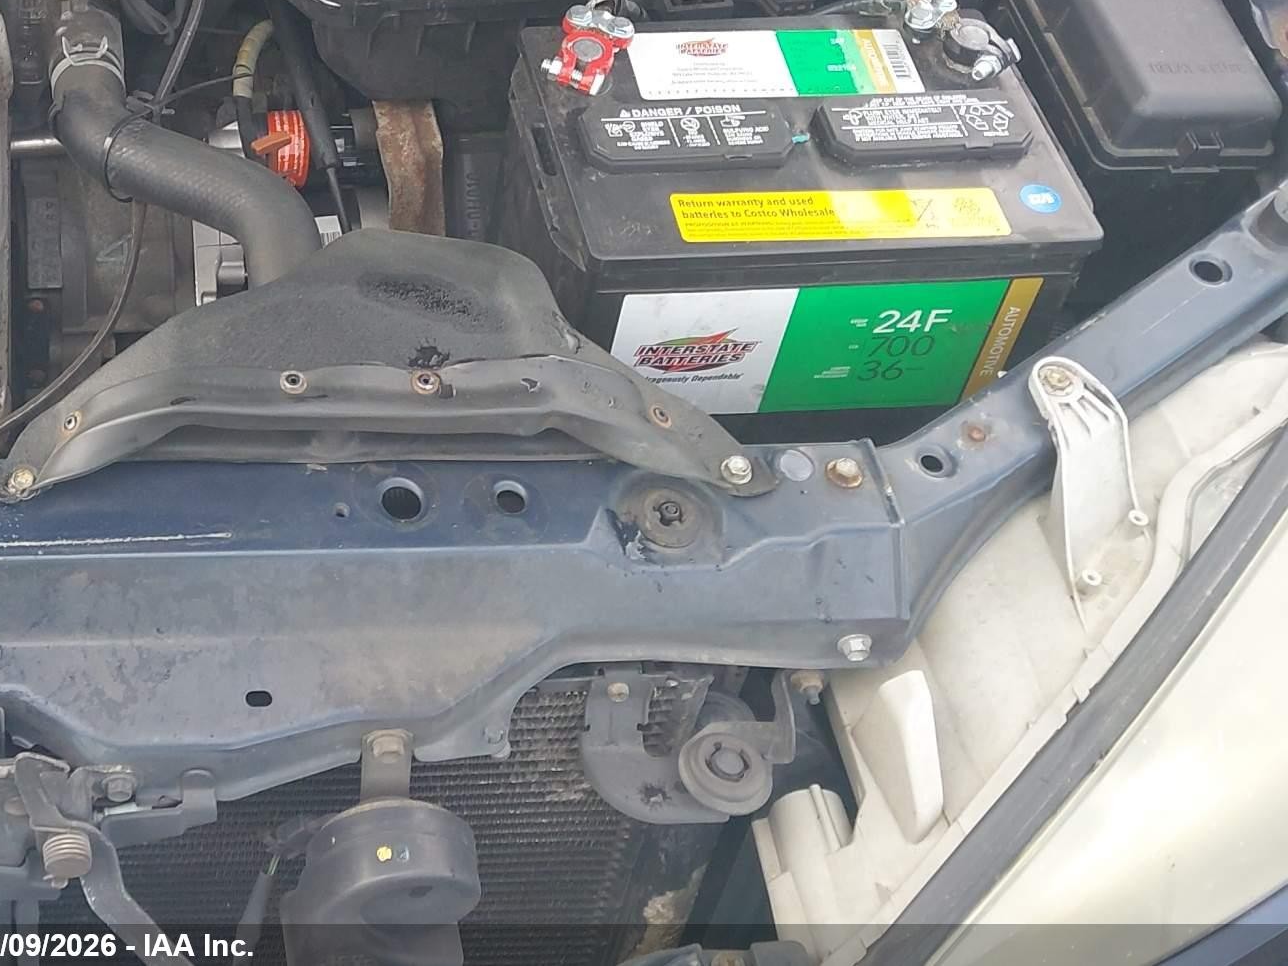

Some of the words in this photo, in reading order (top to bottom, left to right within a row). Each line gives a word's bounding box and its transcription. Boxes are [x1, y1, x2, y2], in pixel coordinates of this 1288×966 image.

[632, 108, 683, 117] DANGER
[695, 104, 741, 115] POISON
[678, 199, 713, 208] Return
[716, 199, 763, 209] warranty
[767, 197, 786, 206] and
[789, 196, 814, 206] used
[682, 210, 728, 219] batteries
[731, 210, 741, 218] to
[744, 209, 777, 218] Costco
[781, 206, 835, 217] Wholesale
[872, 309, 953, 333] 24F
[868, 335, 935, 357] 700
[980, 306, 1021, 377] AUTOMOTIVE
[635, 343, 756, 355] INTERSTATE
[635, 353, 745, 367] BATTERIES
[857, 360, 904, 381] 36
[691, 373, 744, 383] Dependable
